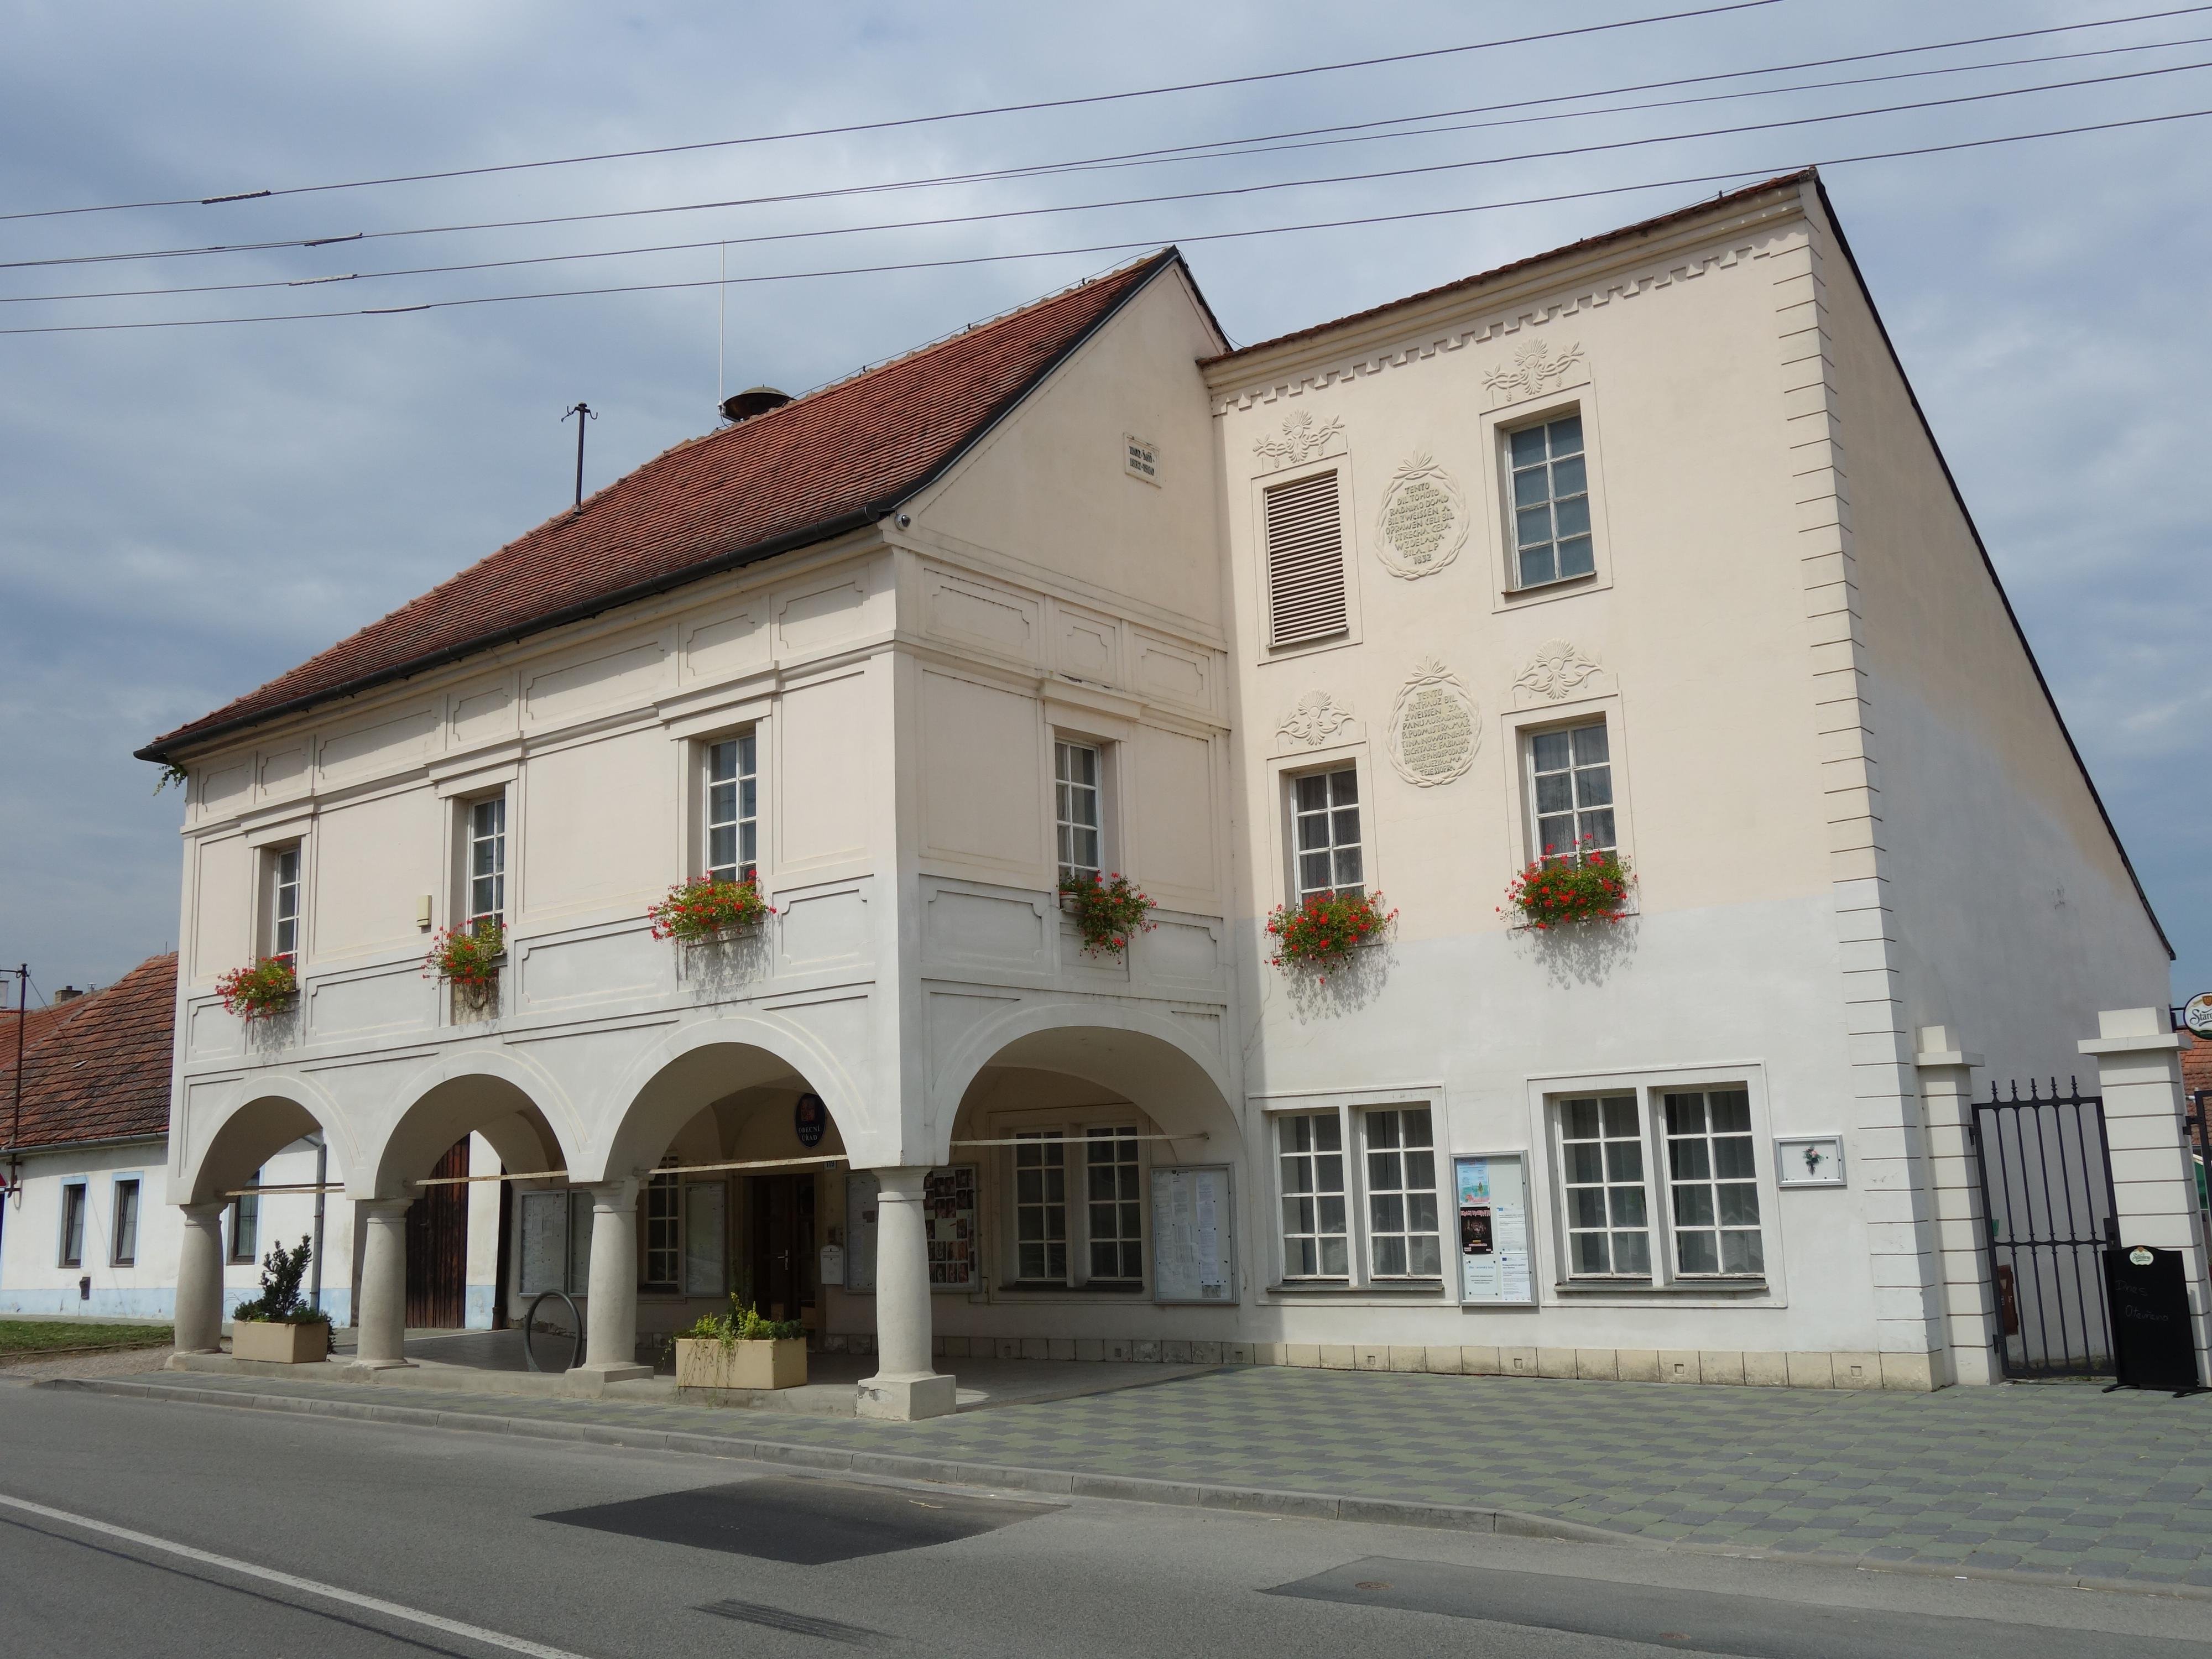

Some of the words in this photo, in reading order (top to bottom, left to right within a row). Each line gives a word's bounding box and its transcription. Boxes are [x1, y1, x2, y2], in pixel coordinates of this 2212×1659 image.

[1405, 482, 1430, 494] TENTO
[1397, 497, 1408, 505] DIL
[1410, 489, 1439, 502] TOHOTO
[1385, 520, 1423, 535] OPRAWEN
[1395, 529, 1430, 542] STRECHA
[1432, 523, 1452, 533] CELA
[1413, 554, 1432, 565] 1832
[1416, 688, 1443, 701] TENTO
[1448, 704, 1461, 712] ZA
[798, 1124, 821, 1133] OBECNÍ
[2115, 1280, 2148, 1297] Dnes
